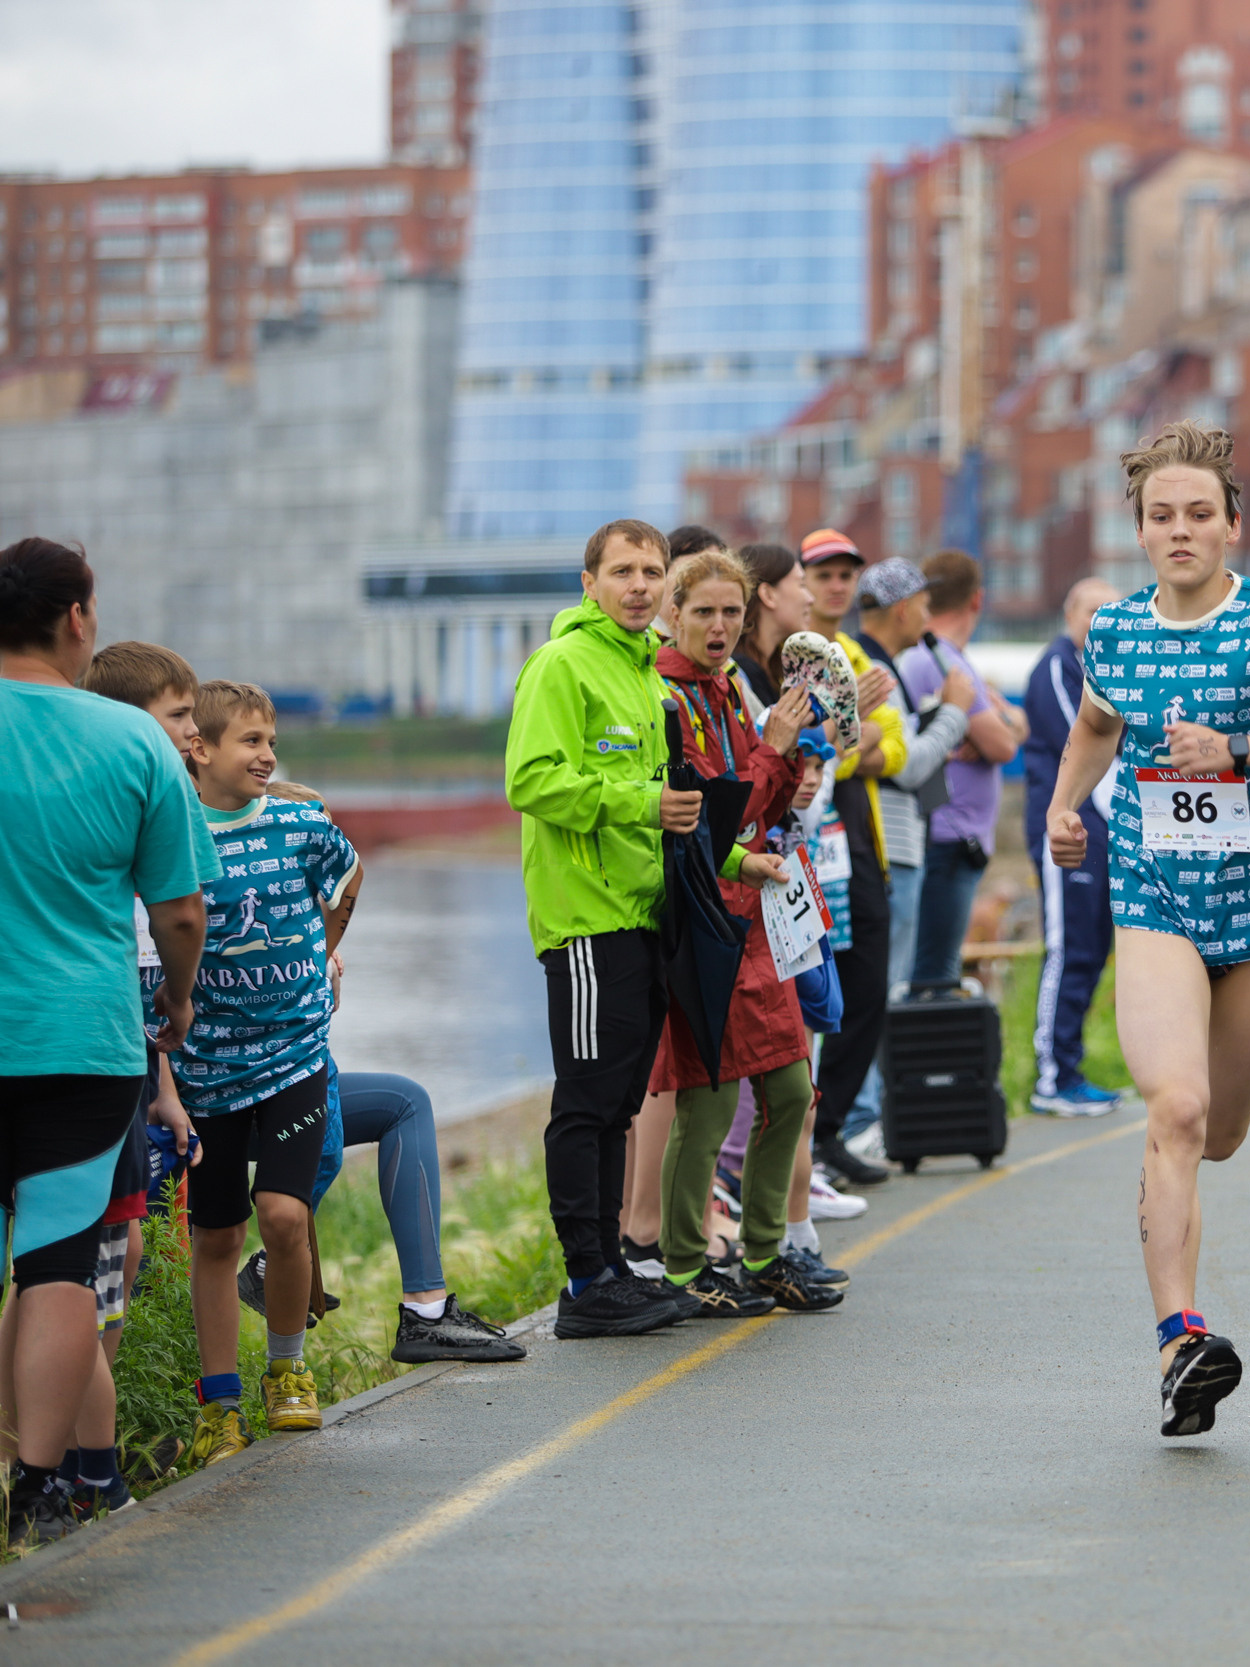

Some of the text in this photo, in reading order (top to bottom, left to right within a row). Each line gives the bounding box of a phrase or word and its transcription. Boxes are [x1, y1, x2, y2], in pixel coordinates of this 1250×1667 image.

[1172, 791, 1218, 824] 86
[785, 880, 812, 923] 31
[213, 990, 298, 1006] Владивосток
